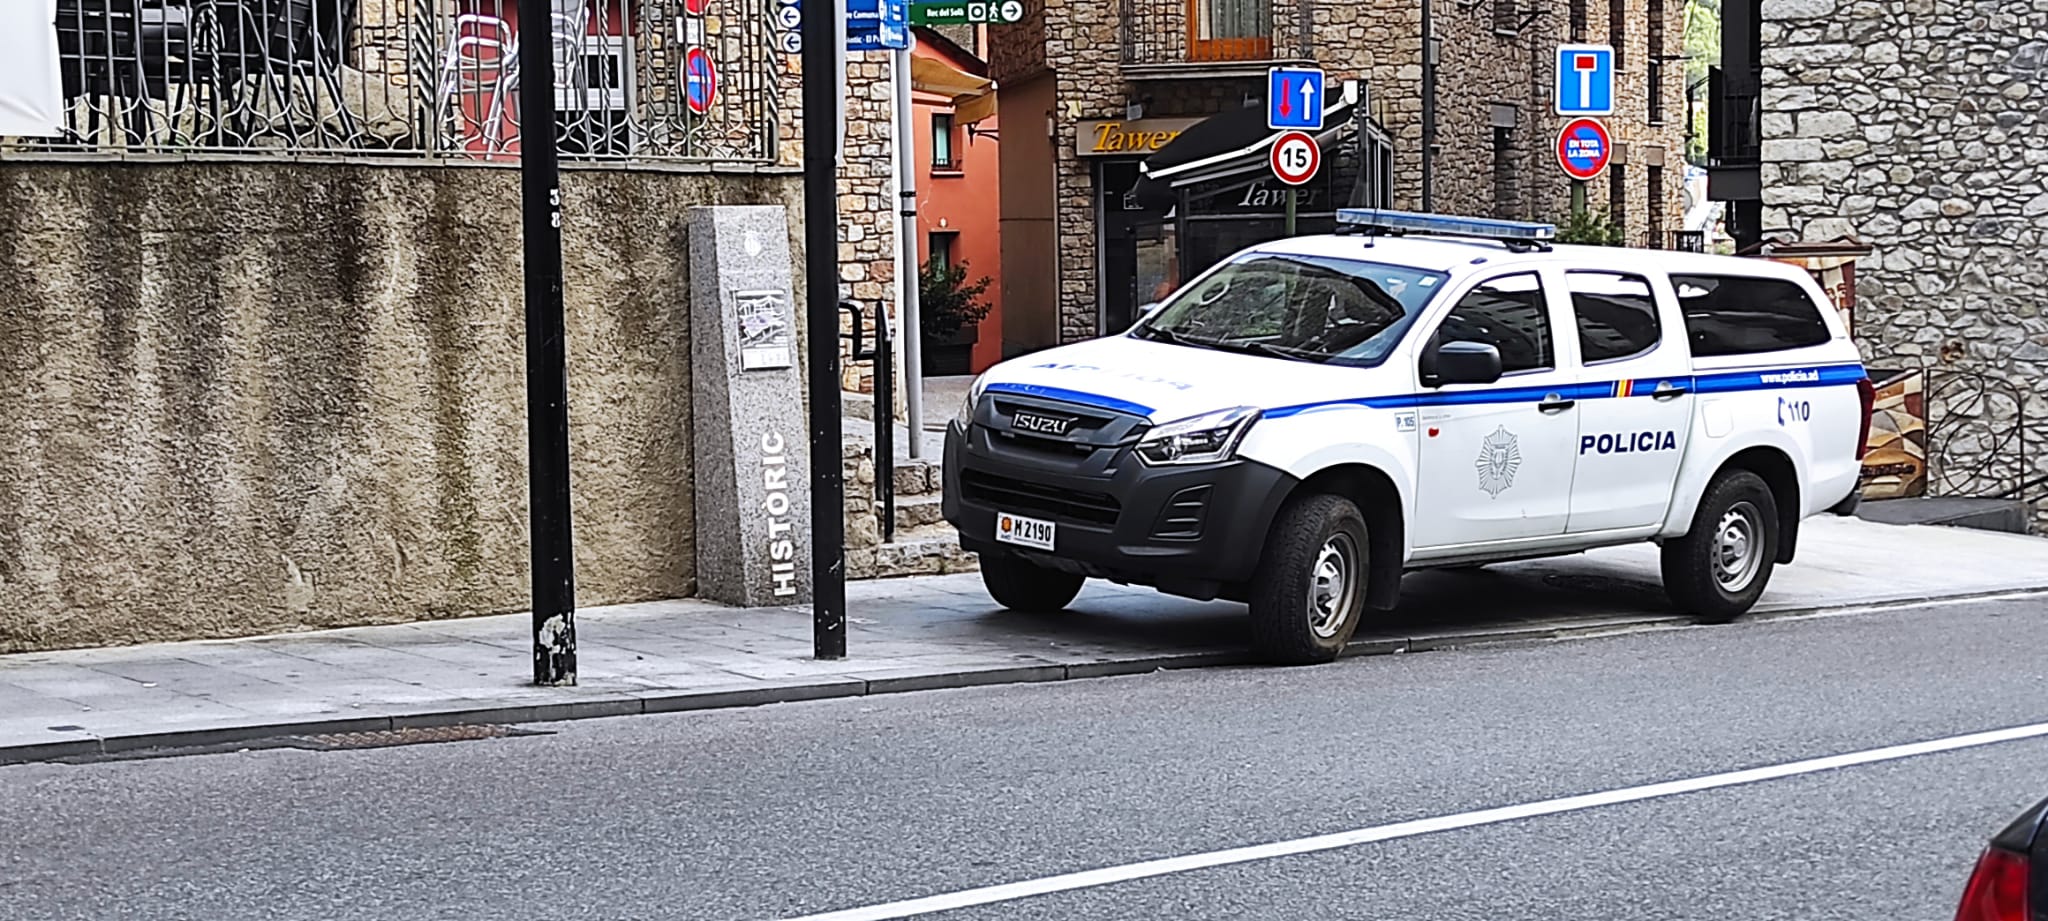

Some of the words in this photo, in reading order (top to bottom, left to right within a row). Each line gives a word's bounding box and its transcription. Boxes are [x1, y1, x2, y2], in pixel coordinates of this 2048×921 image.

[1283, 147, 1307, 168] 15
[1567, 149, 1579, 158] LA
[1578, 149, 1601, 158] ZONA
[1787, 400, 1810, 421] 110
[1013, 413, 1068, 434] ISUZU
[1580, 430, 1677, 455] POLICIA
[761, 431, 797, 597] HISTÒRIC
[1024, 520, 1052, 542] 2190
